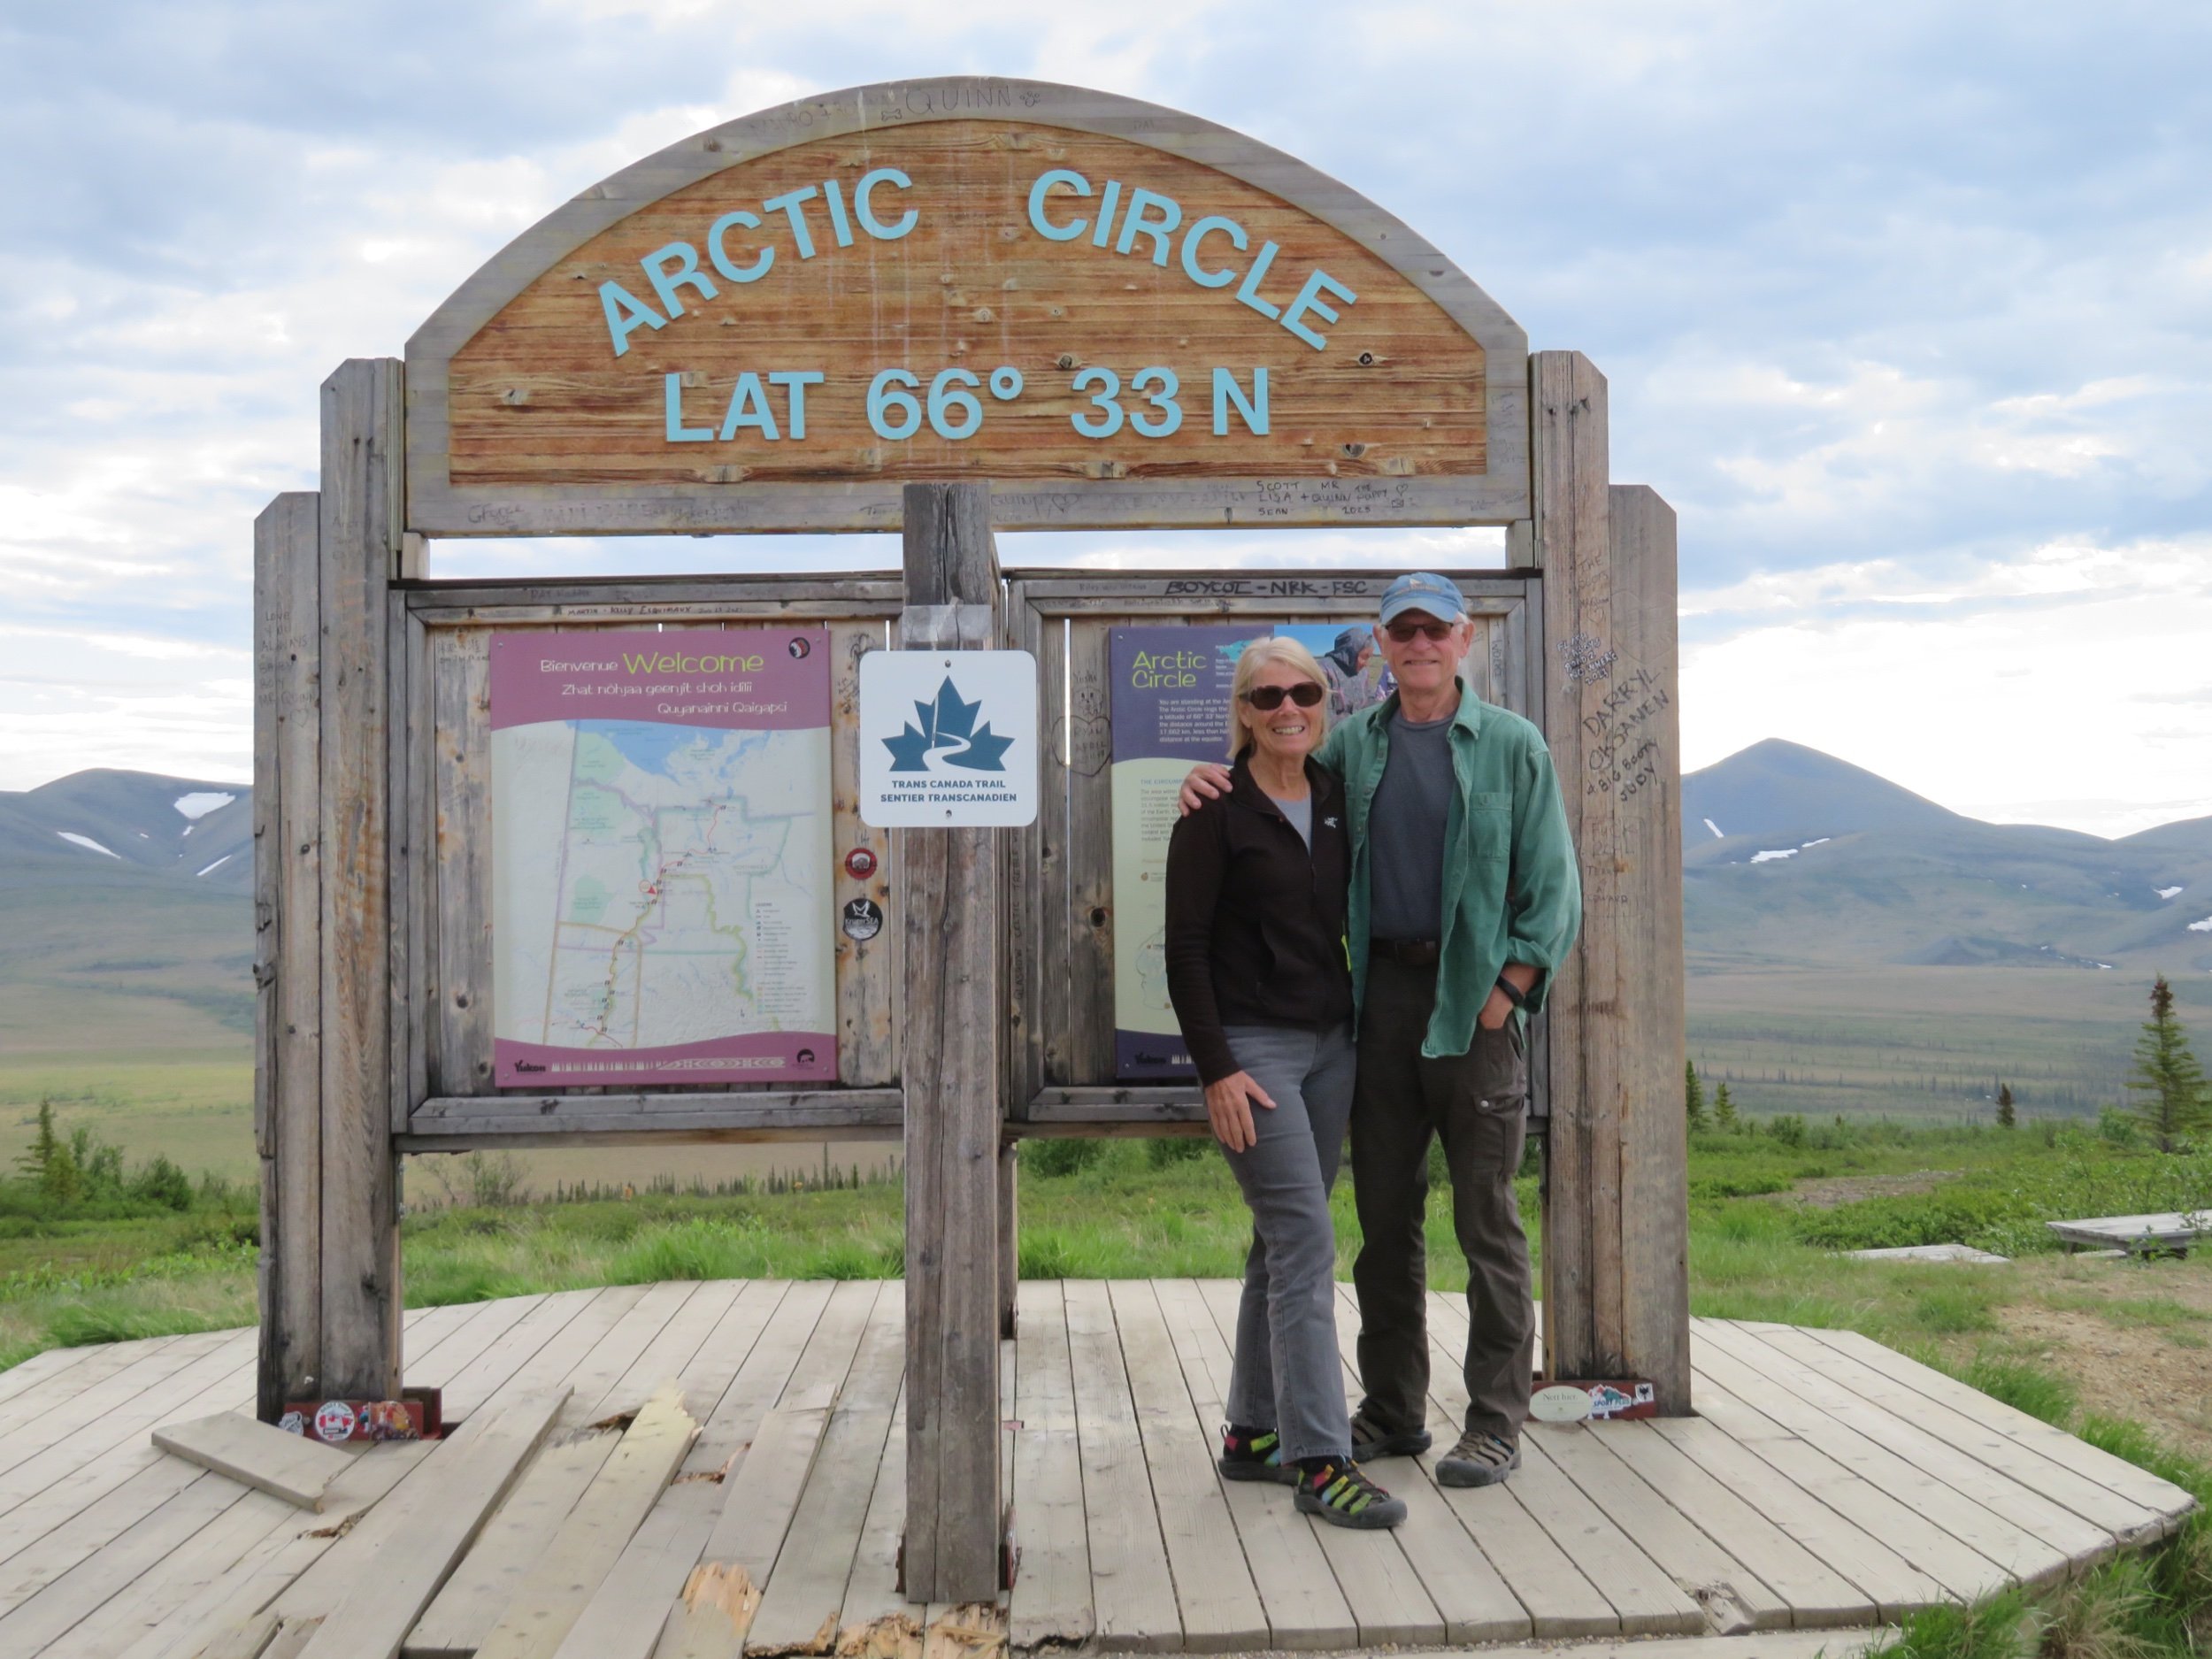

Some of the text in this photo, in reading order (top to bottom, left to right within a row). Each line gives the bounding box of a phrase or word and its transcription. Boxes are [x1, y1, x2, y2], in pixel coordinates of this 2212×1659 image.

[905, 85, 1011, 114] QUINN
[598, 168, 1357, 357] ARCTIC CIRCLE
[665, 366, 1270, 443] LAT 66° 33 N
[541, 651, 764, 674] Bienvenue Welcome
[1133, 650, 1207, 670] Arctic
[562, 684, 593, 695] Zhat
[696, 682, 726, 694] shoh
[1133, 670, 1196, 688] Circle
[1582, 668, 1661, 738] DARRYL
[975, 780, 1006, 788] TRAIL
[514, 1059, 546, 1073] Yukon
